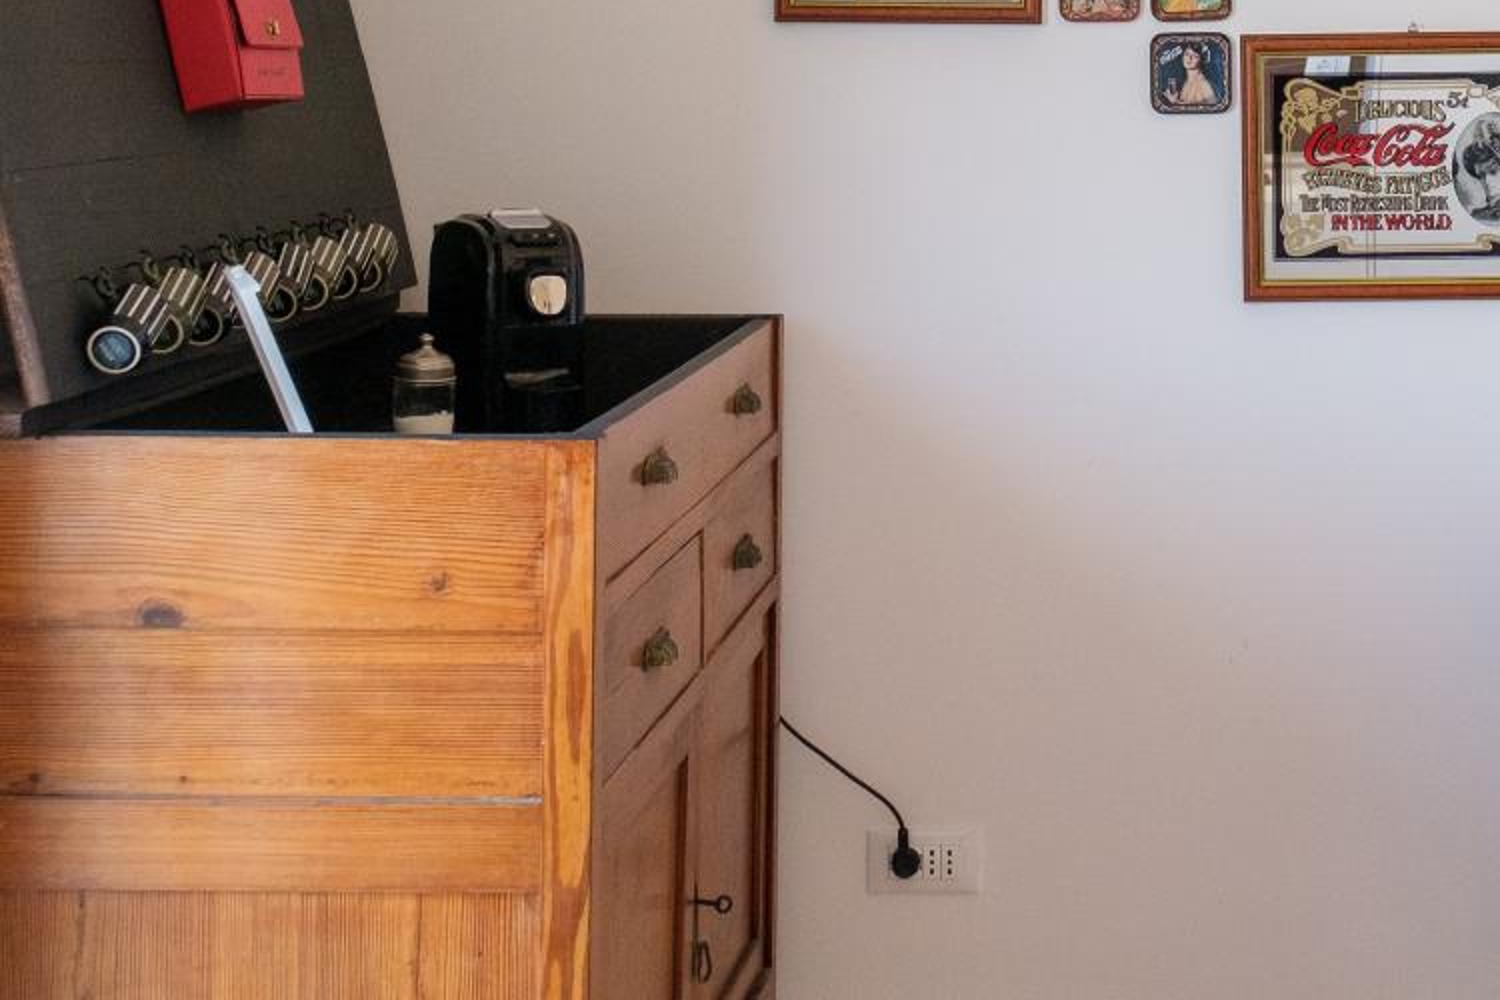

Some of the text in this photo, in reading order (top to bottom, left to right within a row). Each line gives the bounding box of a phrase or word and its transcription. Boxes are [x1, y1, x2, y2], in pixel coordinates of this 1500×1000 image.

[1355, 100, 1447, 122] DELICIOUS
[1331, 214, 1452, 231] IN THE WORLD
